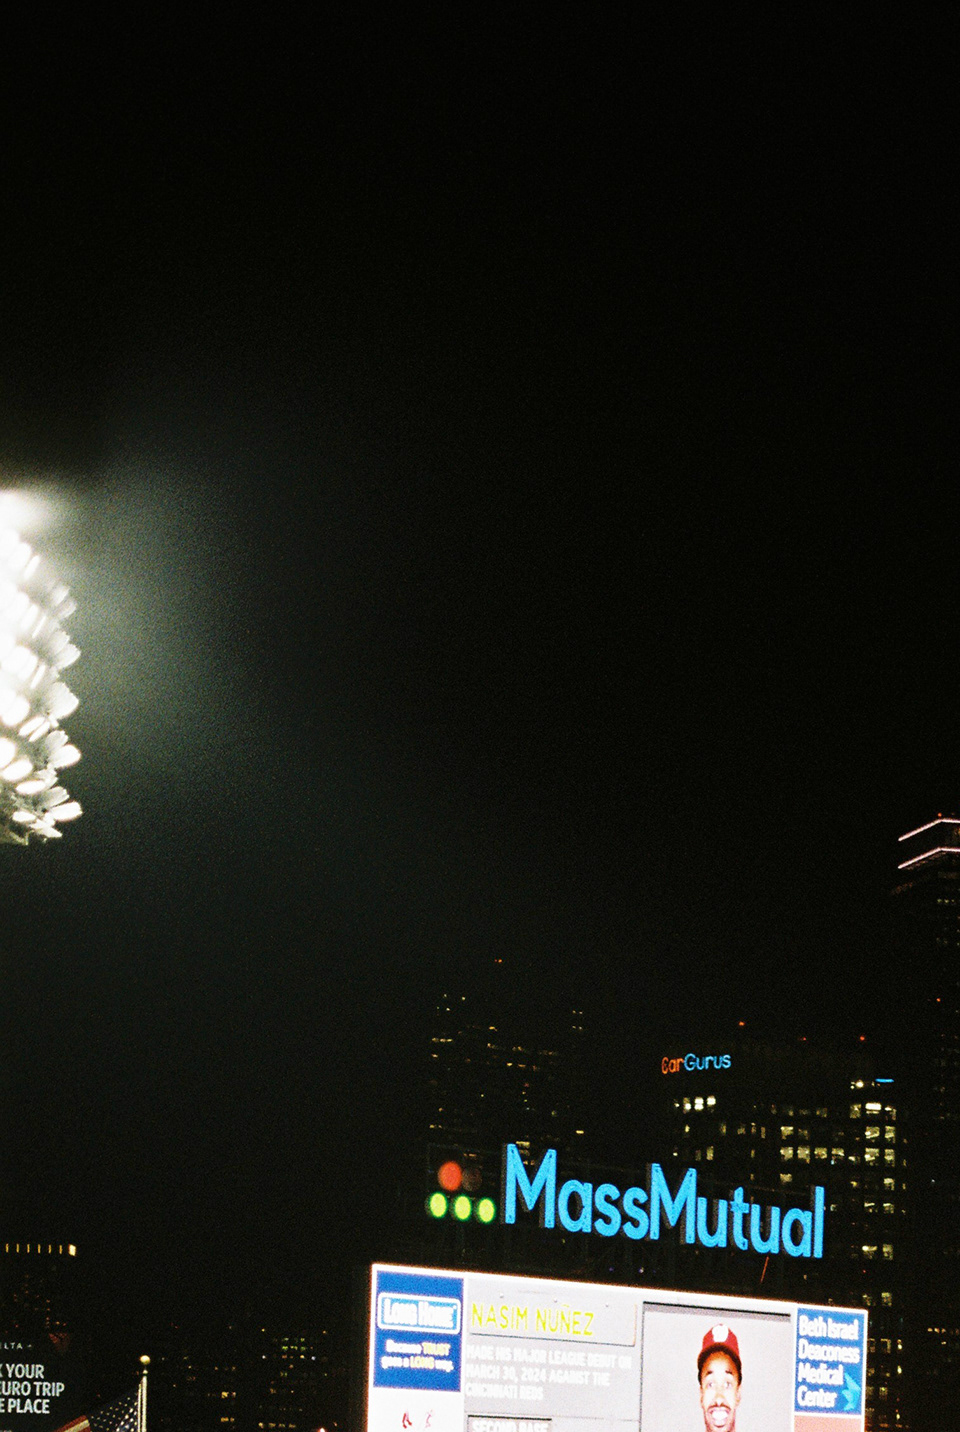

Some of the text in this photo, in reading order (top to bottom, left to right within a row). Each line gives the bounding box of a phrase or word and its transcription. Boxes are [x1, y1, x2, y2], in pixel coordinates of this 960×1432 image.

[661, 1053, 732, 1075] CarGurus
[504, 1143, 825, 1259] MassMutual
[472, 1302, 528, 1331] NASIM
[799, 1315, 859, 1341] Beth Israel
[421, 1342, 451, 1356] TRUST
[513, 1347, 547, 1363] MAJOR
[548, 1349, 586, 1366] LEAGUE
[798, 1338, 860, 1364] Deaconess
[6, 1363, 45, 1379] YOUR
[410, 1355, 435, 1369] LONG
[465, 1363, 500, 1379] MARCH
[548, 1369, 591, 1385] AGAINST
[592, 1371, 611, 1387] THE
[798, 1361, 844, 1386] Medical
[33, 1381, 65, 1397] TRIP
[797, 1385, 838, 1408] Center
[7, 1398, 50, 1414] PLACE
